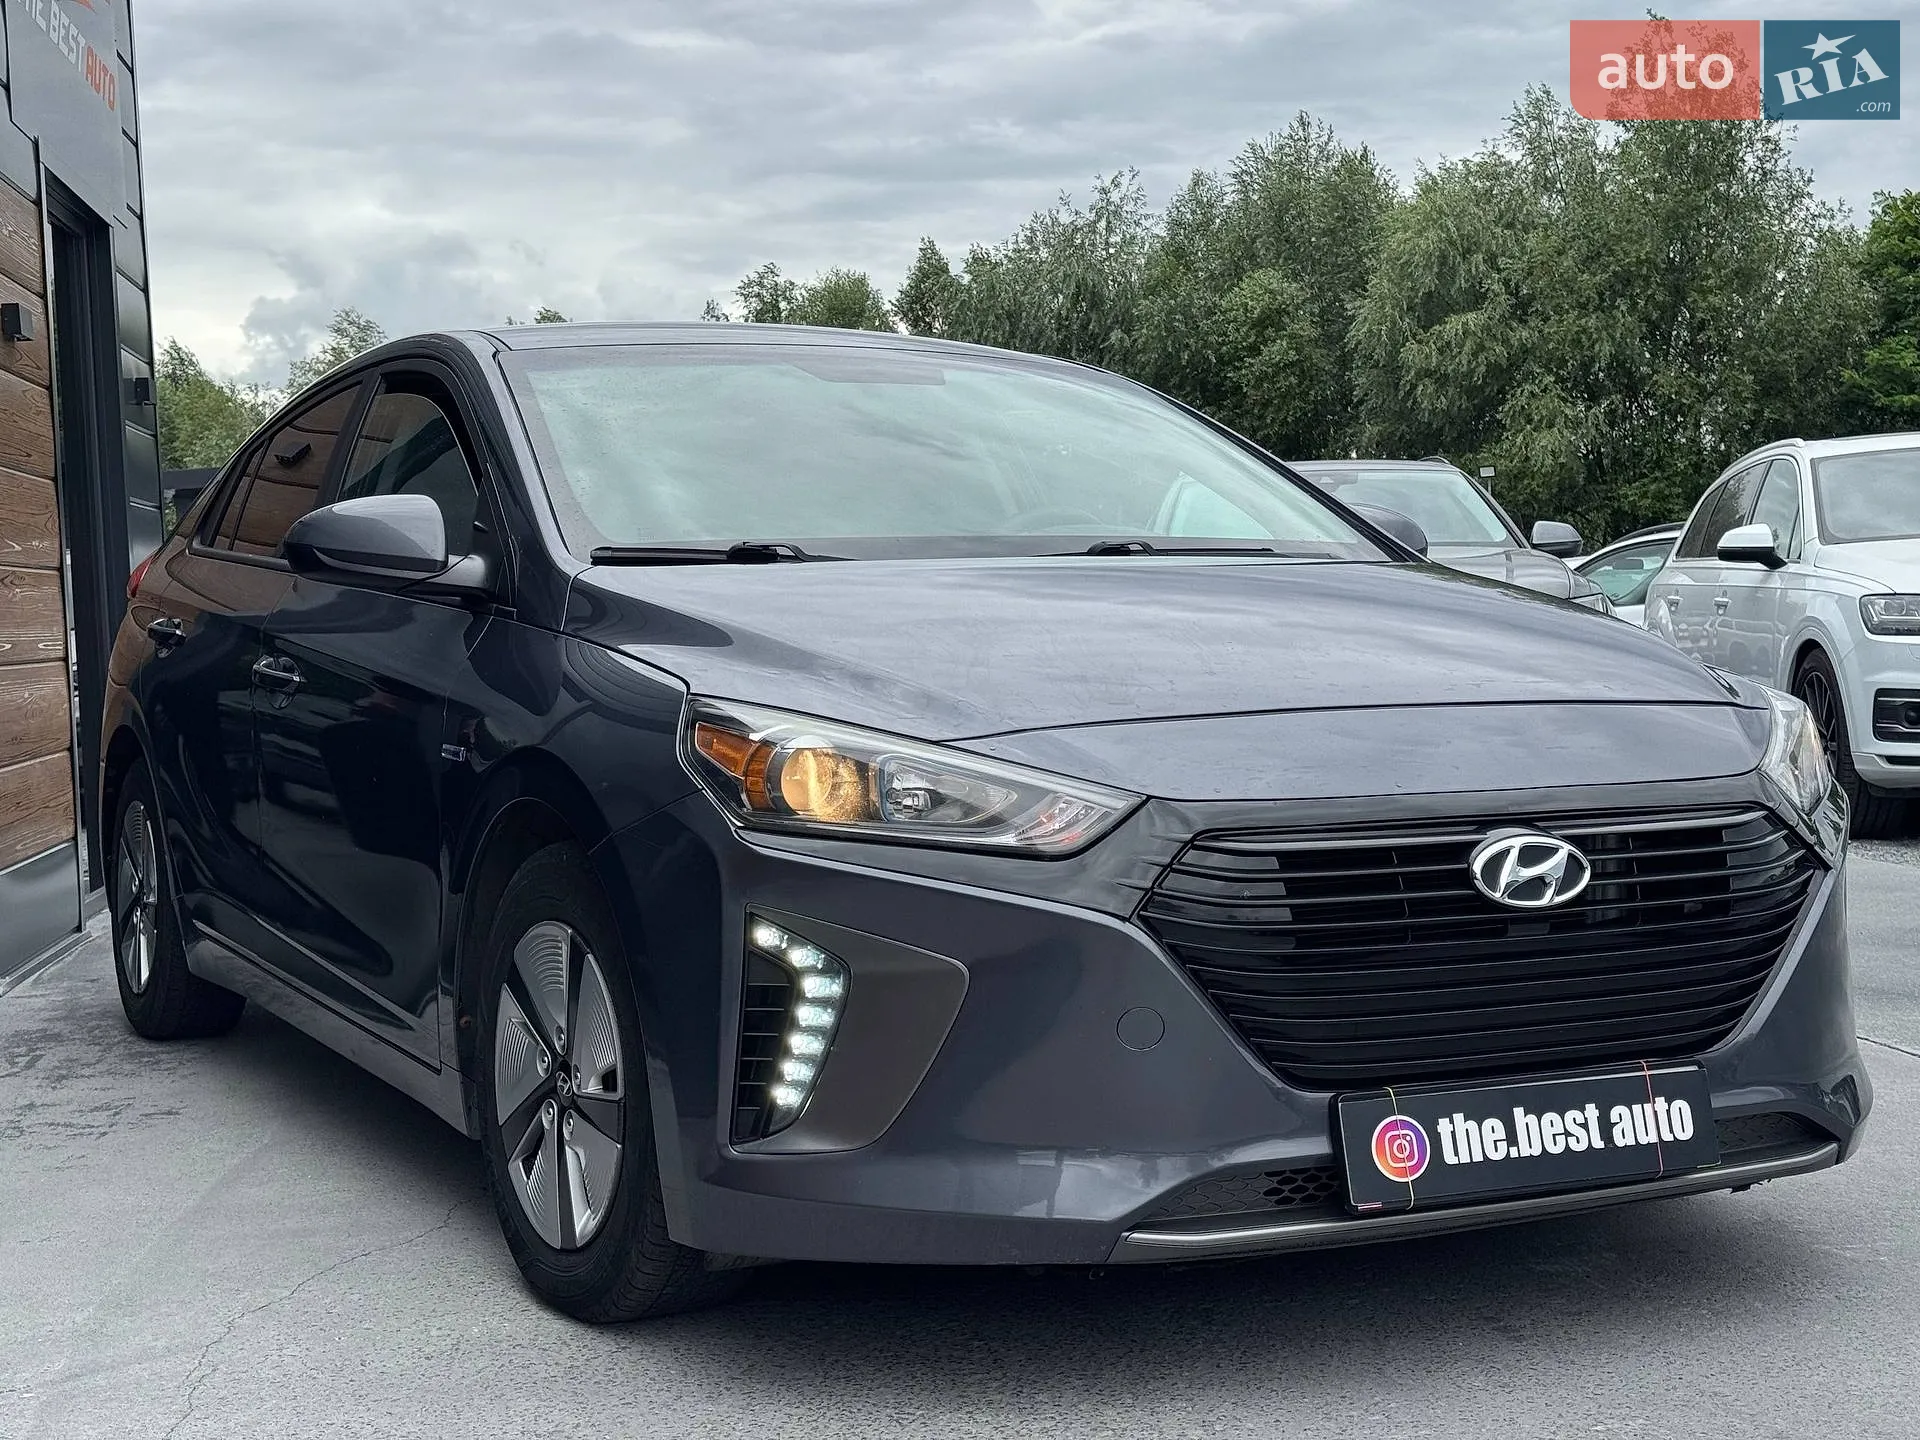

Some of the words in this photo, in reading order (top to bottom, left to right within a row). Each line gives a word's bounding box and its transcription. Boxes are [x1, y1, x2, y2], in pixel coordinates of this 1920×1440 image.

[49, 0, 86, 73] BEST
[85, 45, 116, 112] AUTO
[1438, 1103, 1604, 1165] the.best
[1610, 1096, 1695, 1148] auto
